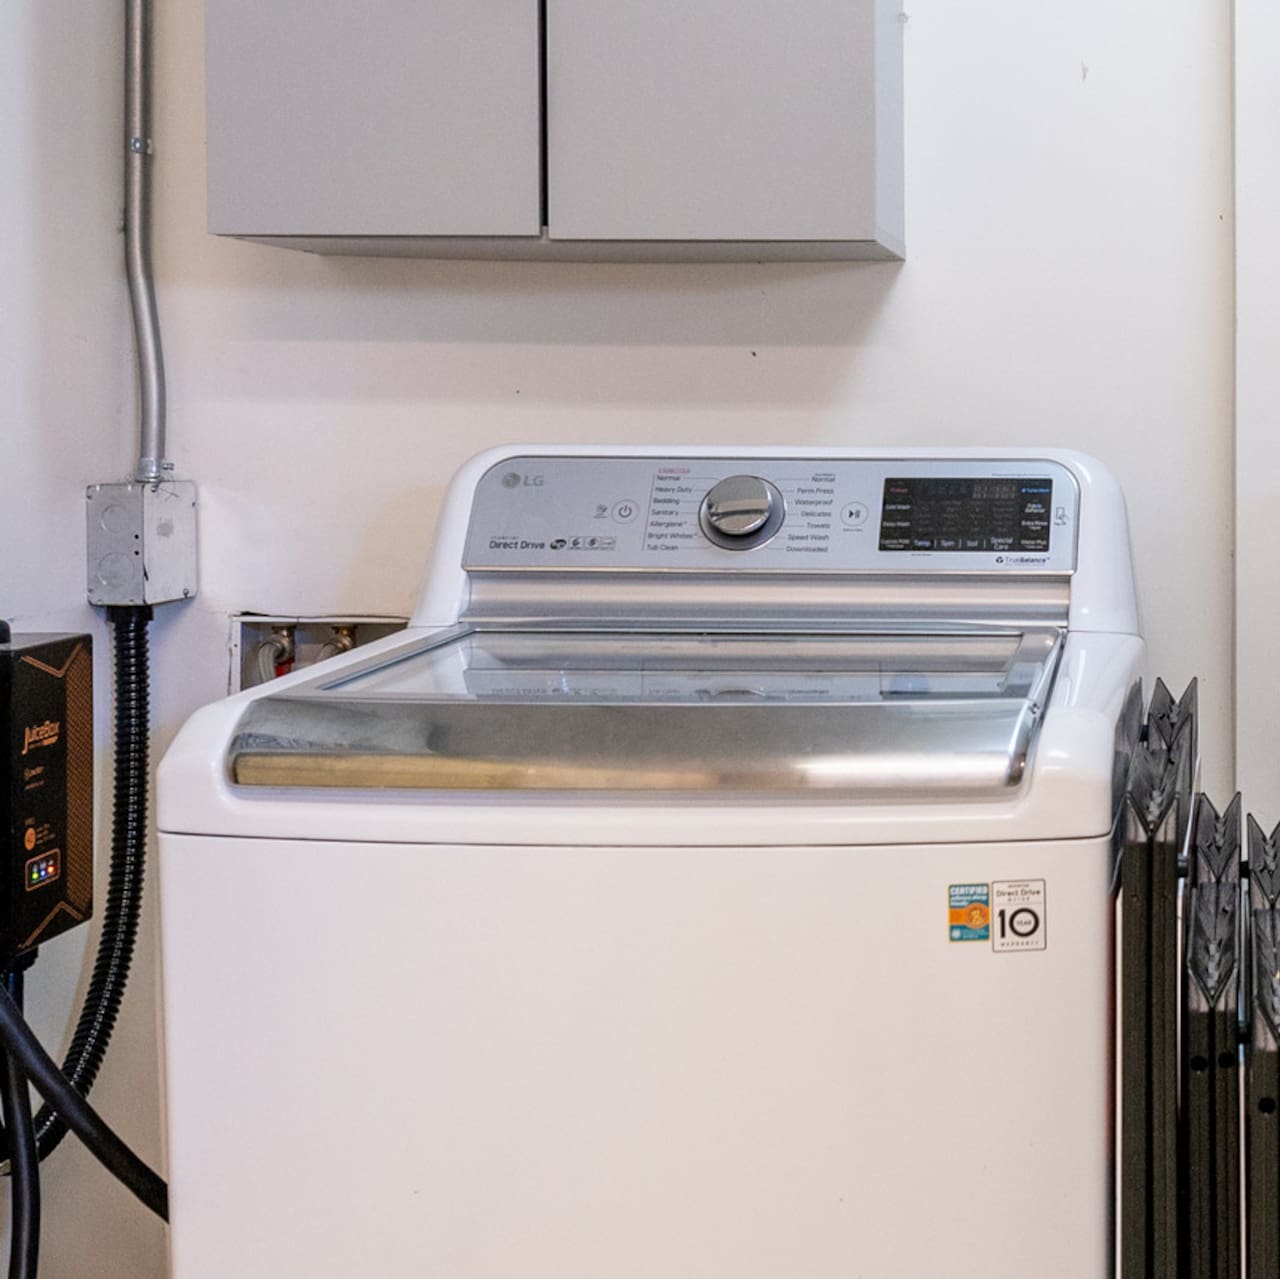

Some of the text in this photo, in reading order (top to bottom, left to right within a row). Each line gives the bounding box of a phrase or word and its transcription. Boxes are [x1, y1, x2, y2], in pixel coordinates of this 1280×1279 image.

[656, 486, 675, 494] Heavy
[653, 497, 680, 505] Bedding
[794, 498, 833, 506] Waterproof
[489, 540, 545, 550] Direct Drive
[21, 720, 61, 755] JuiceBox
[1020, 888, 1040, 896] Drive
[998, 908, 1039, 938] 10
